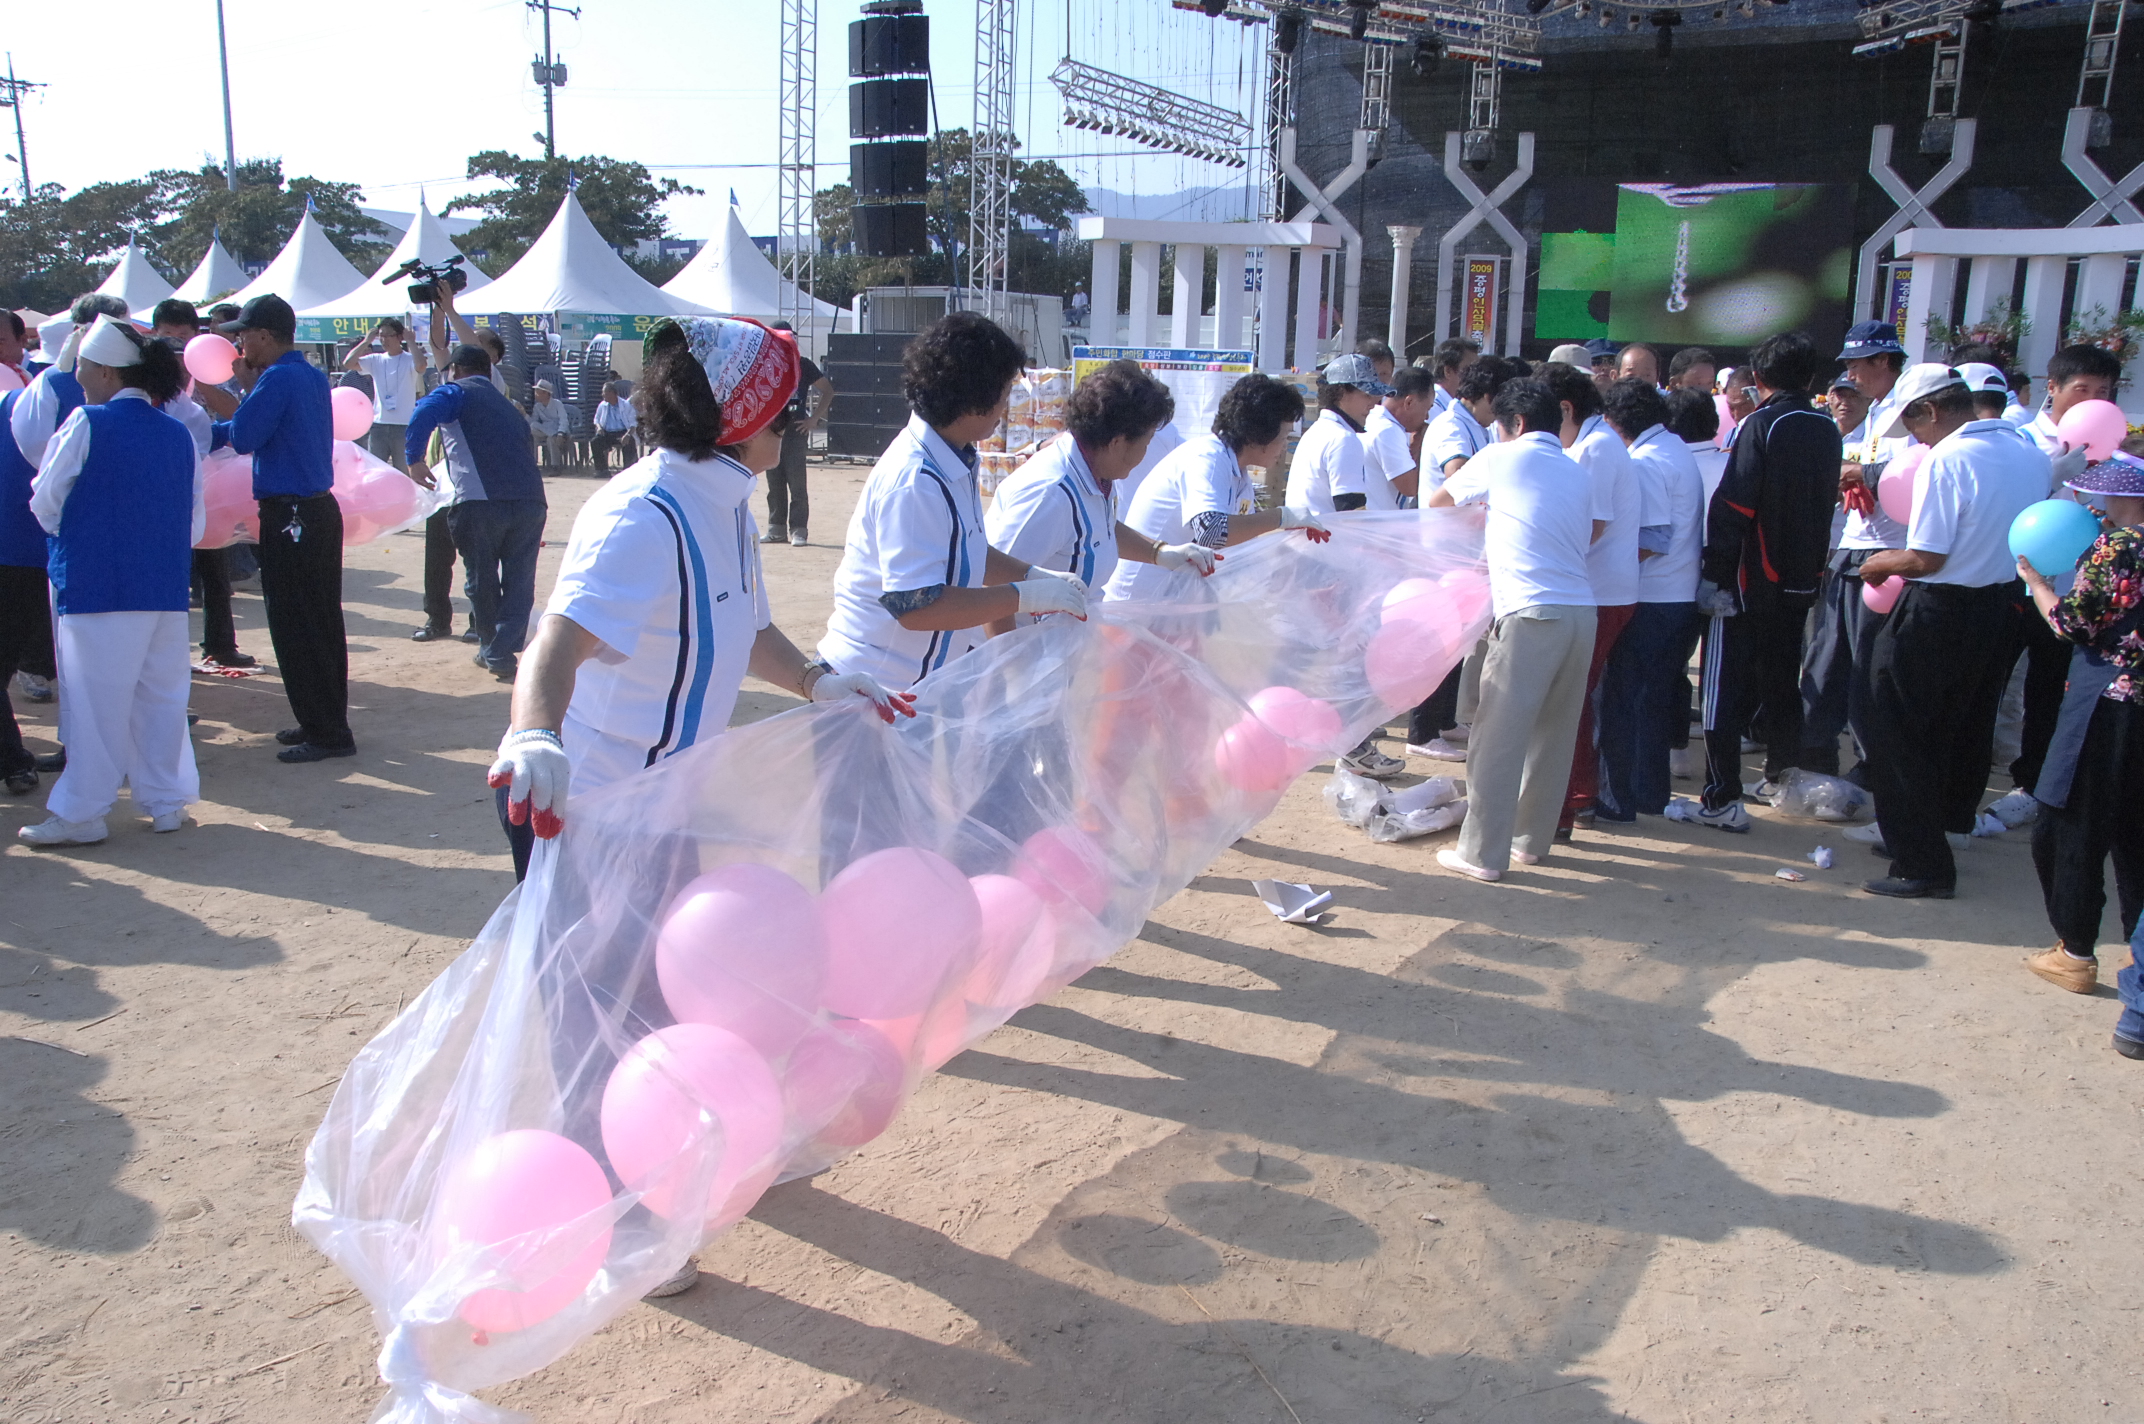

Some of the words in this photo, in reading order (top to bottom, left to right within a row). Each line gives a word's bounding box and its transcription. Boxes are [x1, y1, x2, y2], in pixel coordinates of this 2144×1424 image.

[1470, 264, 1492, 273] 2009
[1896, 270, 1912, 280] 200
[333, 317, 381, 335] 안내
[1087, 348, 1118, 358] 주민화합
[1121, 349, 1145, 359] 한마당
[1147, 350, 1171, 360] 점수판
